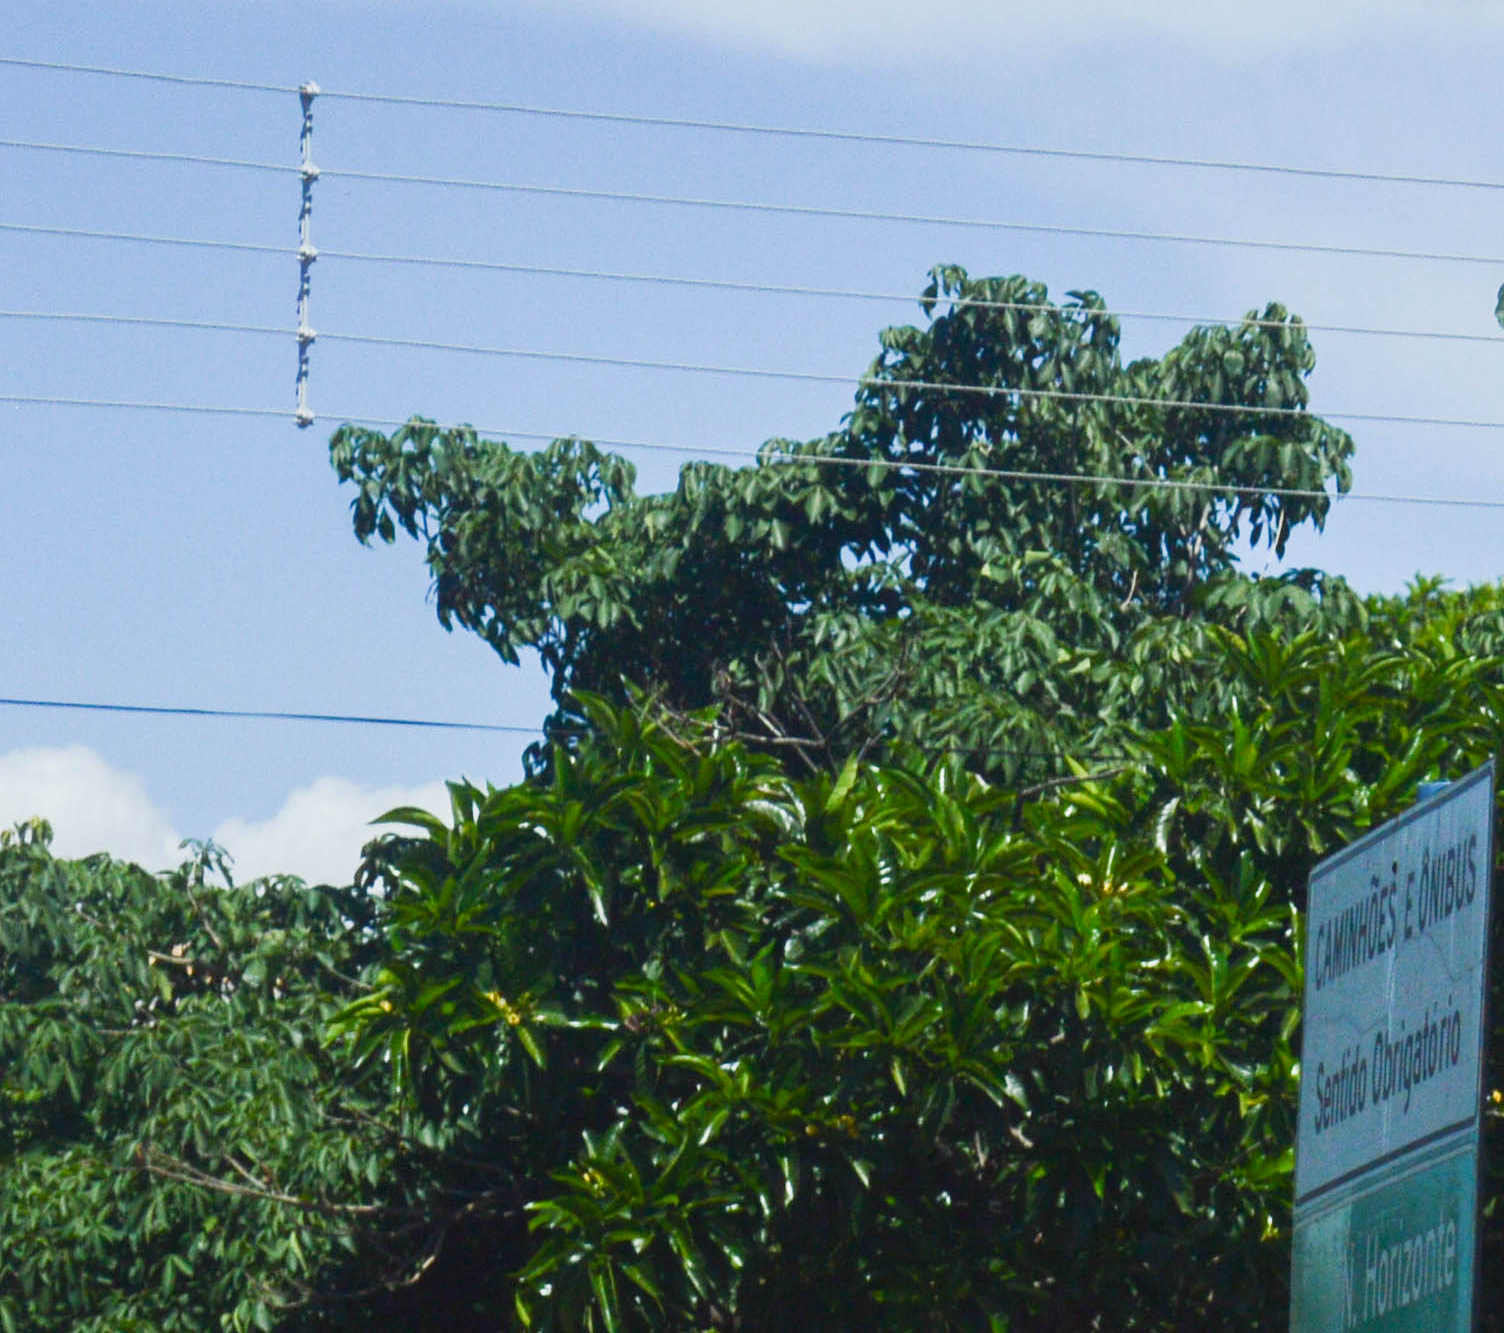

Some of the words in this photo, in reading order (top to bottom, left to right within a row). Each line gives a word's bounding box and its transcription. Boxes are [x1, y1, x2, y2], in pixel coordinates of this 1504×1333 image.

[1315, 874, 1397, 992] CAMINHÕES
[1404, 870, 1415, 940] E
[1418, 834, 1477, 932] ÔNIBUS
[1314, 1044, 1367, 1134] Sentido
[1372, 993, 1461, 1115] Obrigatório
[1363, 1204, 1456, 1322] Horizonte
